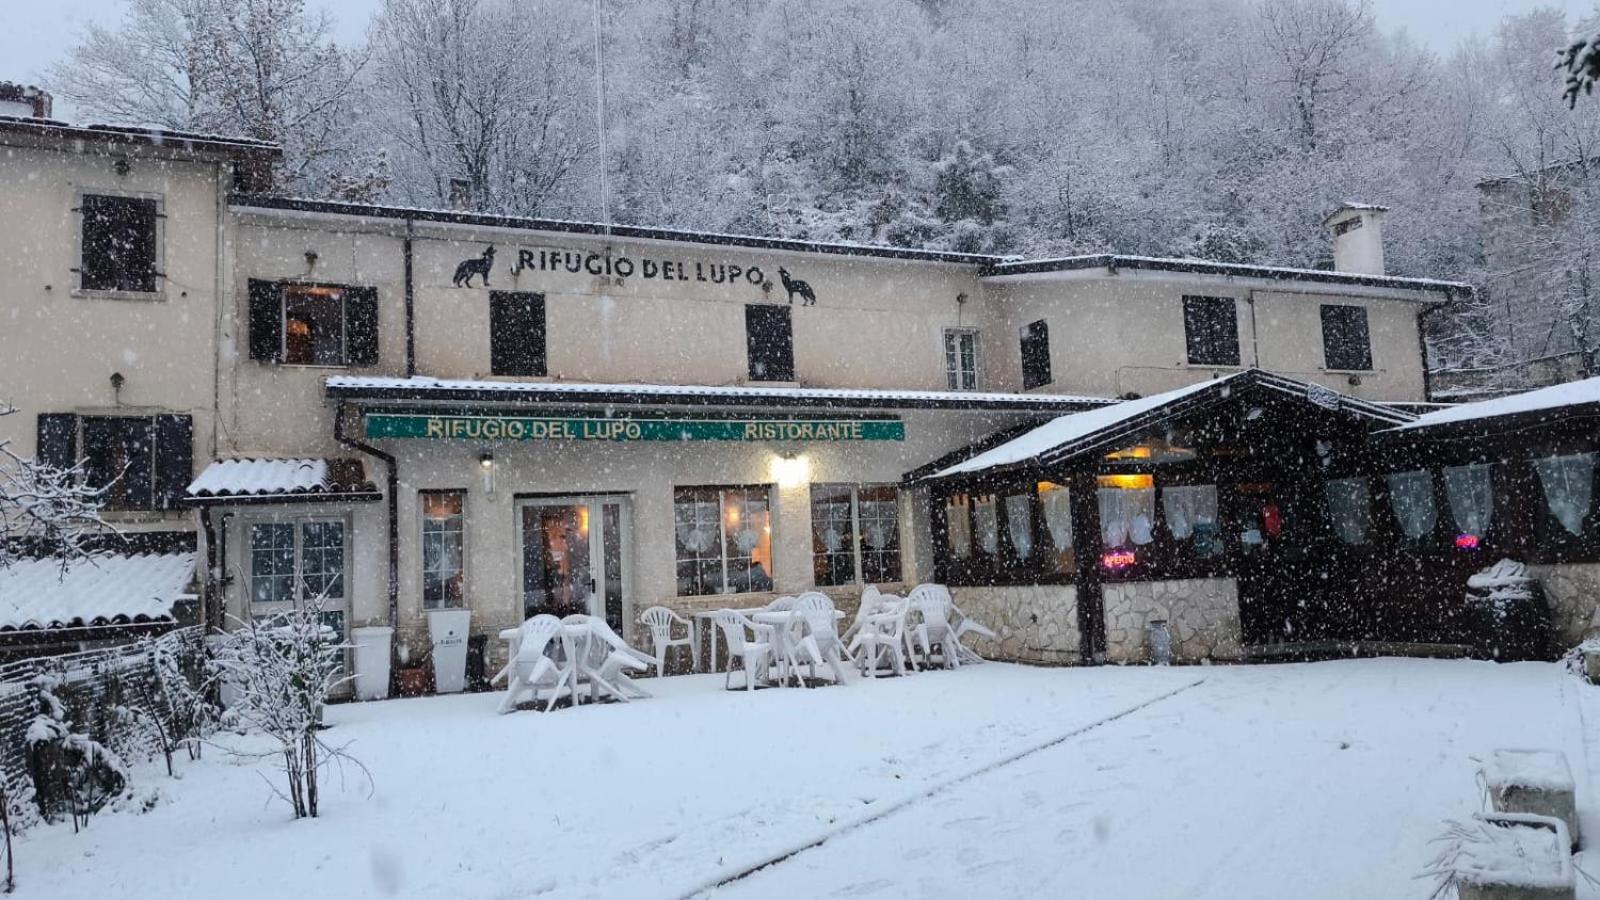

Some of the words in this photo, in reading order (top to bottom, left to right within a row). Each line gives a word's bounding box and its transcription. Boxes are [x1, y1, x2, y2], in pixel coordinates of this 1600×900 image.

[518, 249, 634, 278] RIFUGIO
[643, 259, 689, 282] DEL
[696, 262, 764, 285] LUPO
[427, 418, 524, 438] RIFUGIO
[532, 420, 576, 438] DEL
[583, 421, 641, 439] LUPO
[745, 422, 863, 440] RISTORANTE
